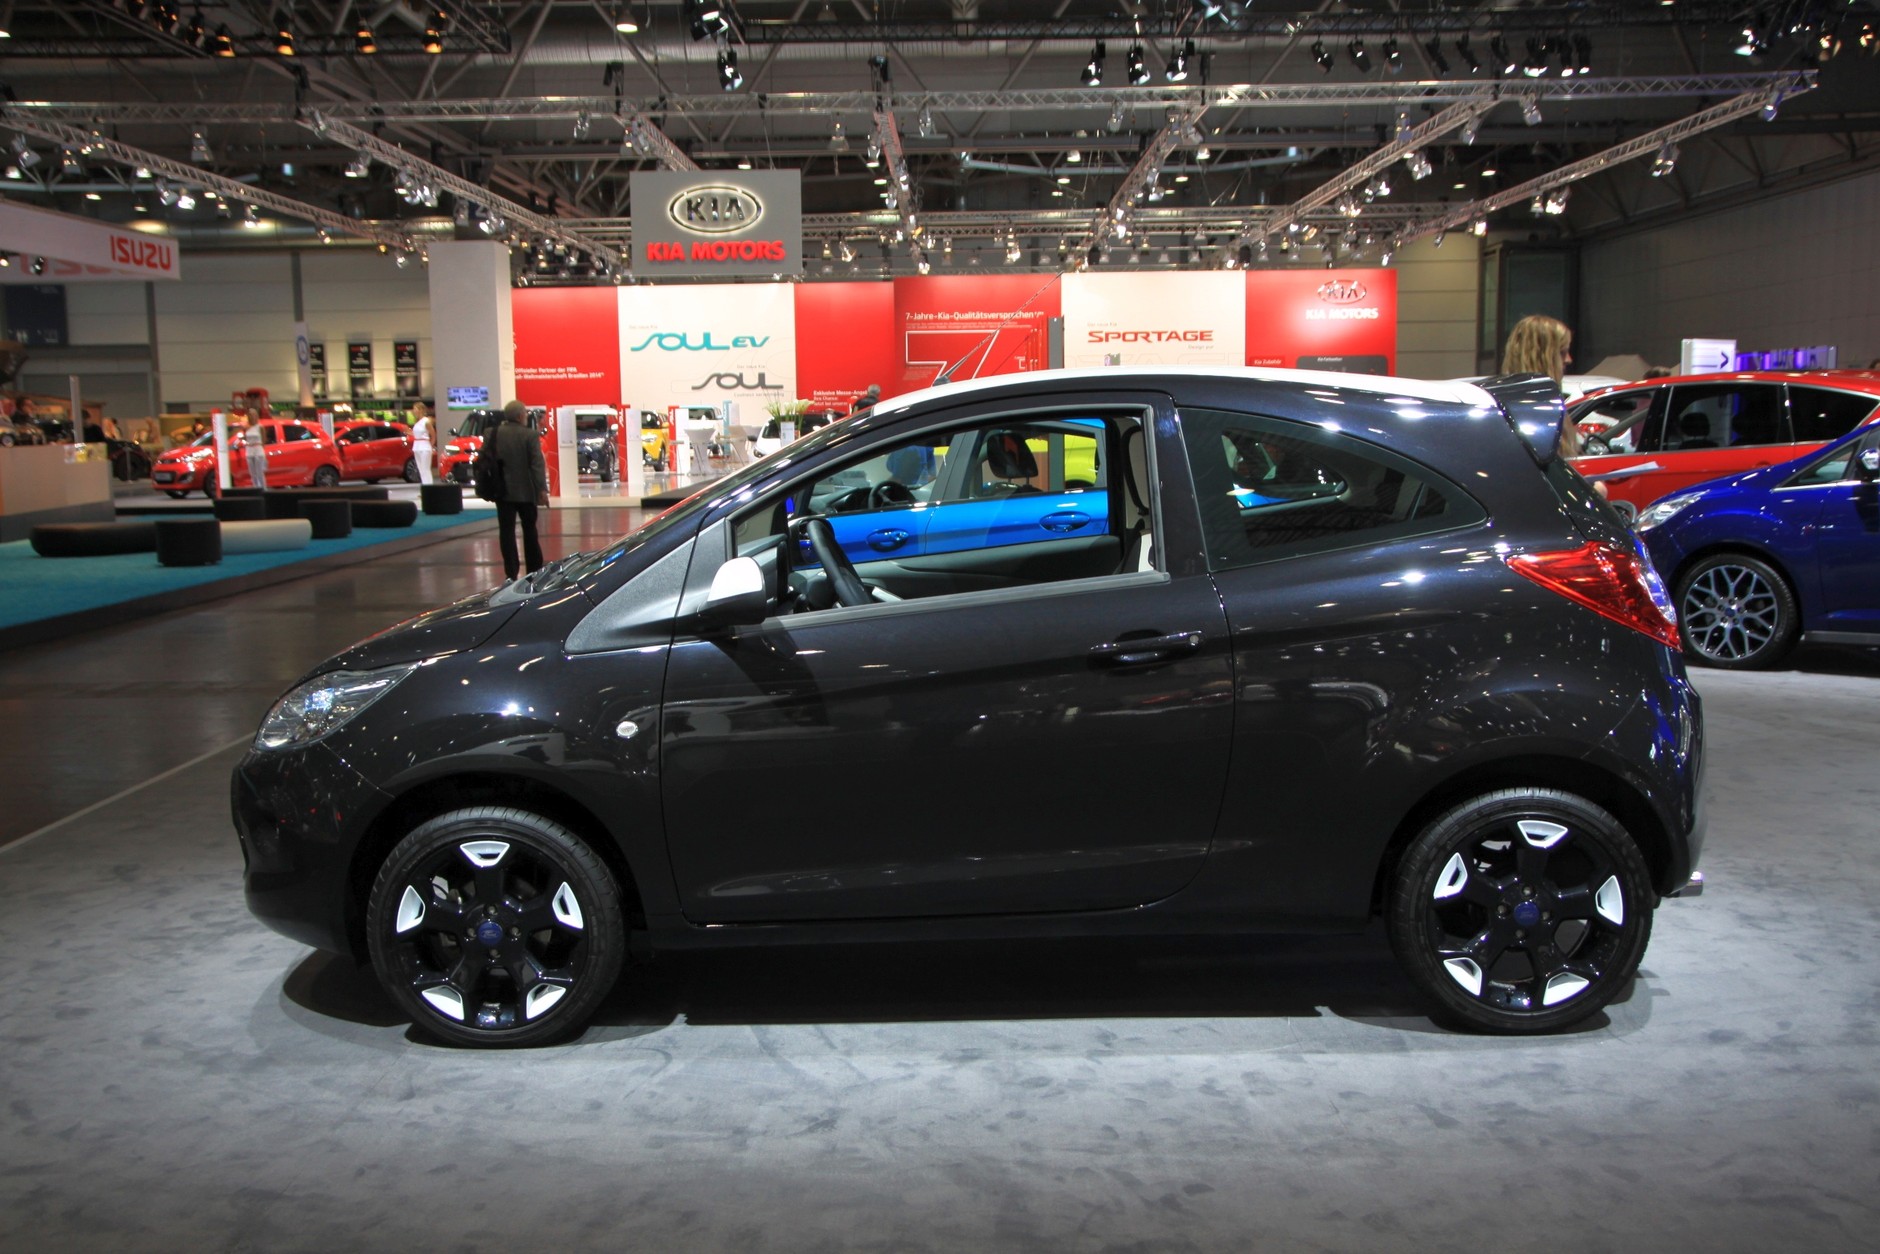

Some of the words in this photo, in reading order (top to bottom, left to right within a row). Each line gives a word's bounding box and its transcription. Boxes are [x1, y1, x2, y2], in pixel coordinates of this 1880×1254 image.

[686, 196, 746, 222] KIA
[110, 235, 172, 271] ISUZU
[647, 242, 686, 262] KIA
[691, 240, 787, 262] MOTORS
[1327, 285, 1359, 299] KIA
[1305, 309, 1327, 320] KIA
[1328, 307, 1380, 320] MOTORS
[630, 331, 730, 352] SOUL
[1087, 329, 1214, 344] SPORTAGE
[691, 372, 784, 390] SOUL
[480, 929, 499, 939] Ford
